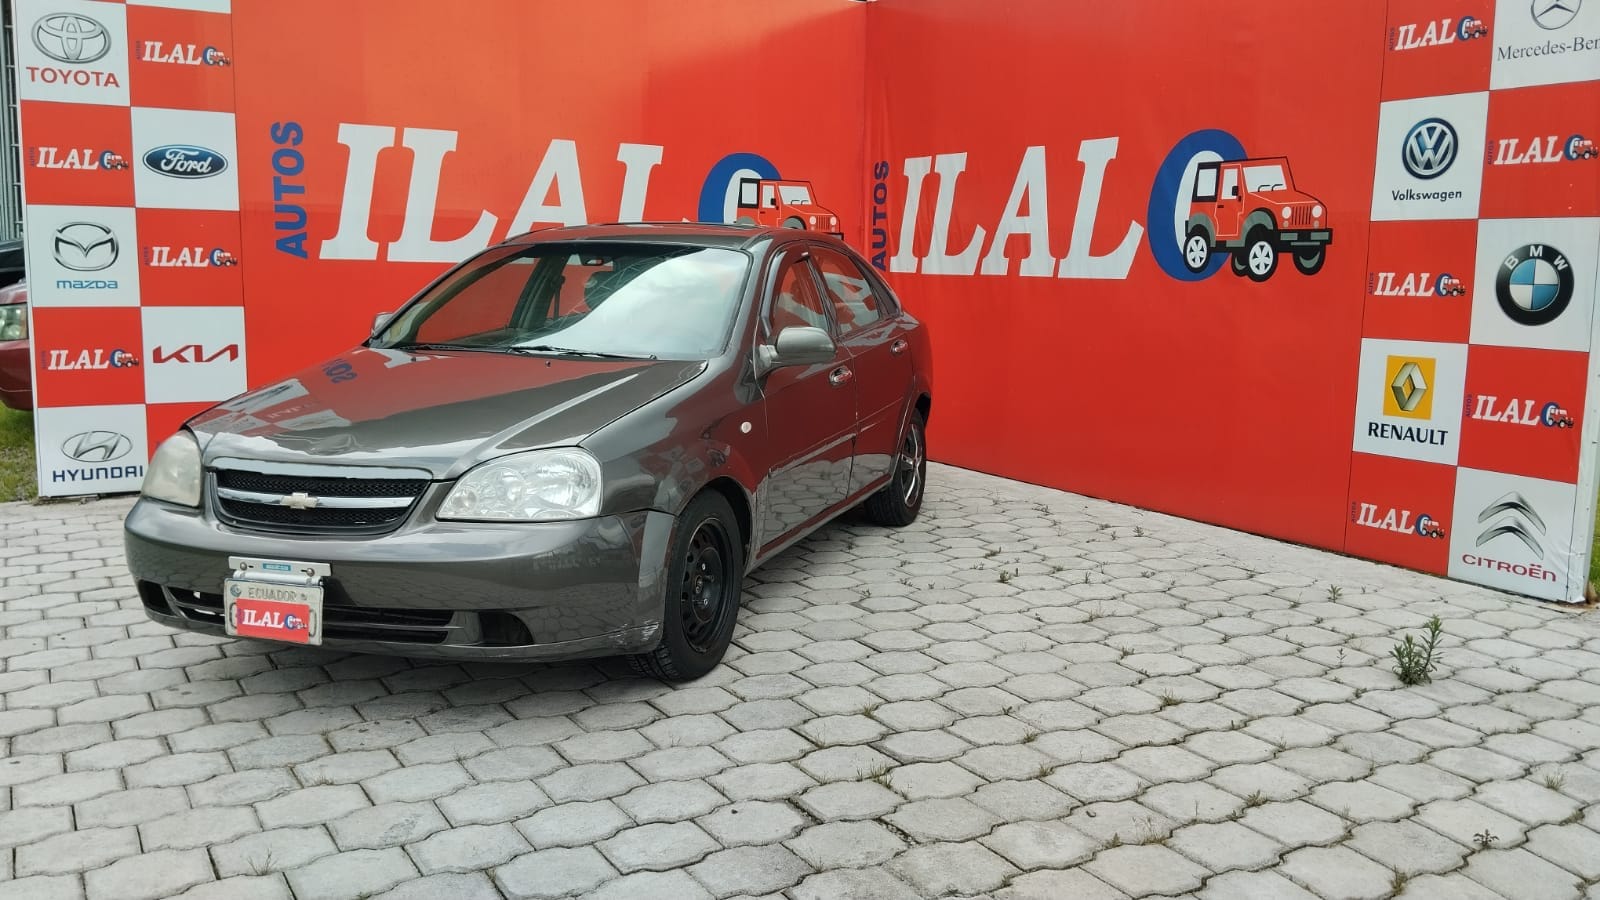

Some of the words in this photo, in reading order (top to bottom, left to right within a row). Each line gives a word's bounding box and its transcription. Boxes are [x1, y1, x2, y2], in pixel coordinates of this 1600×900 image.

[26, 66, 120, 88] TOYOTA
[160, 149, 213, 174] Ford
[271, 121, 308, 259] AUTOS
[1392, 189, 1462, 202] Volkswagen
[872, 160, 889, 272] AUTOS
[1503, 245, 1569, 271] BMW
[56, 279, 119, 289] mazda
[1368, 421, 1449, 446] RENAULT
[52, 465, 144, 483] HYUNDAI
[248, 587, 297, 601] ECUADOR
